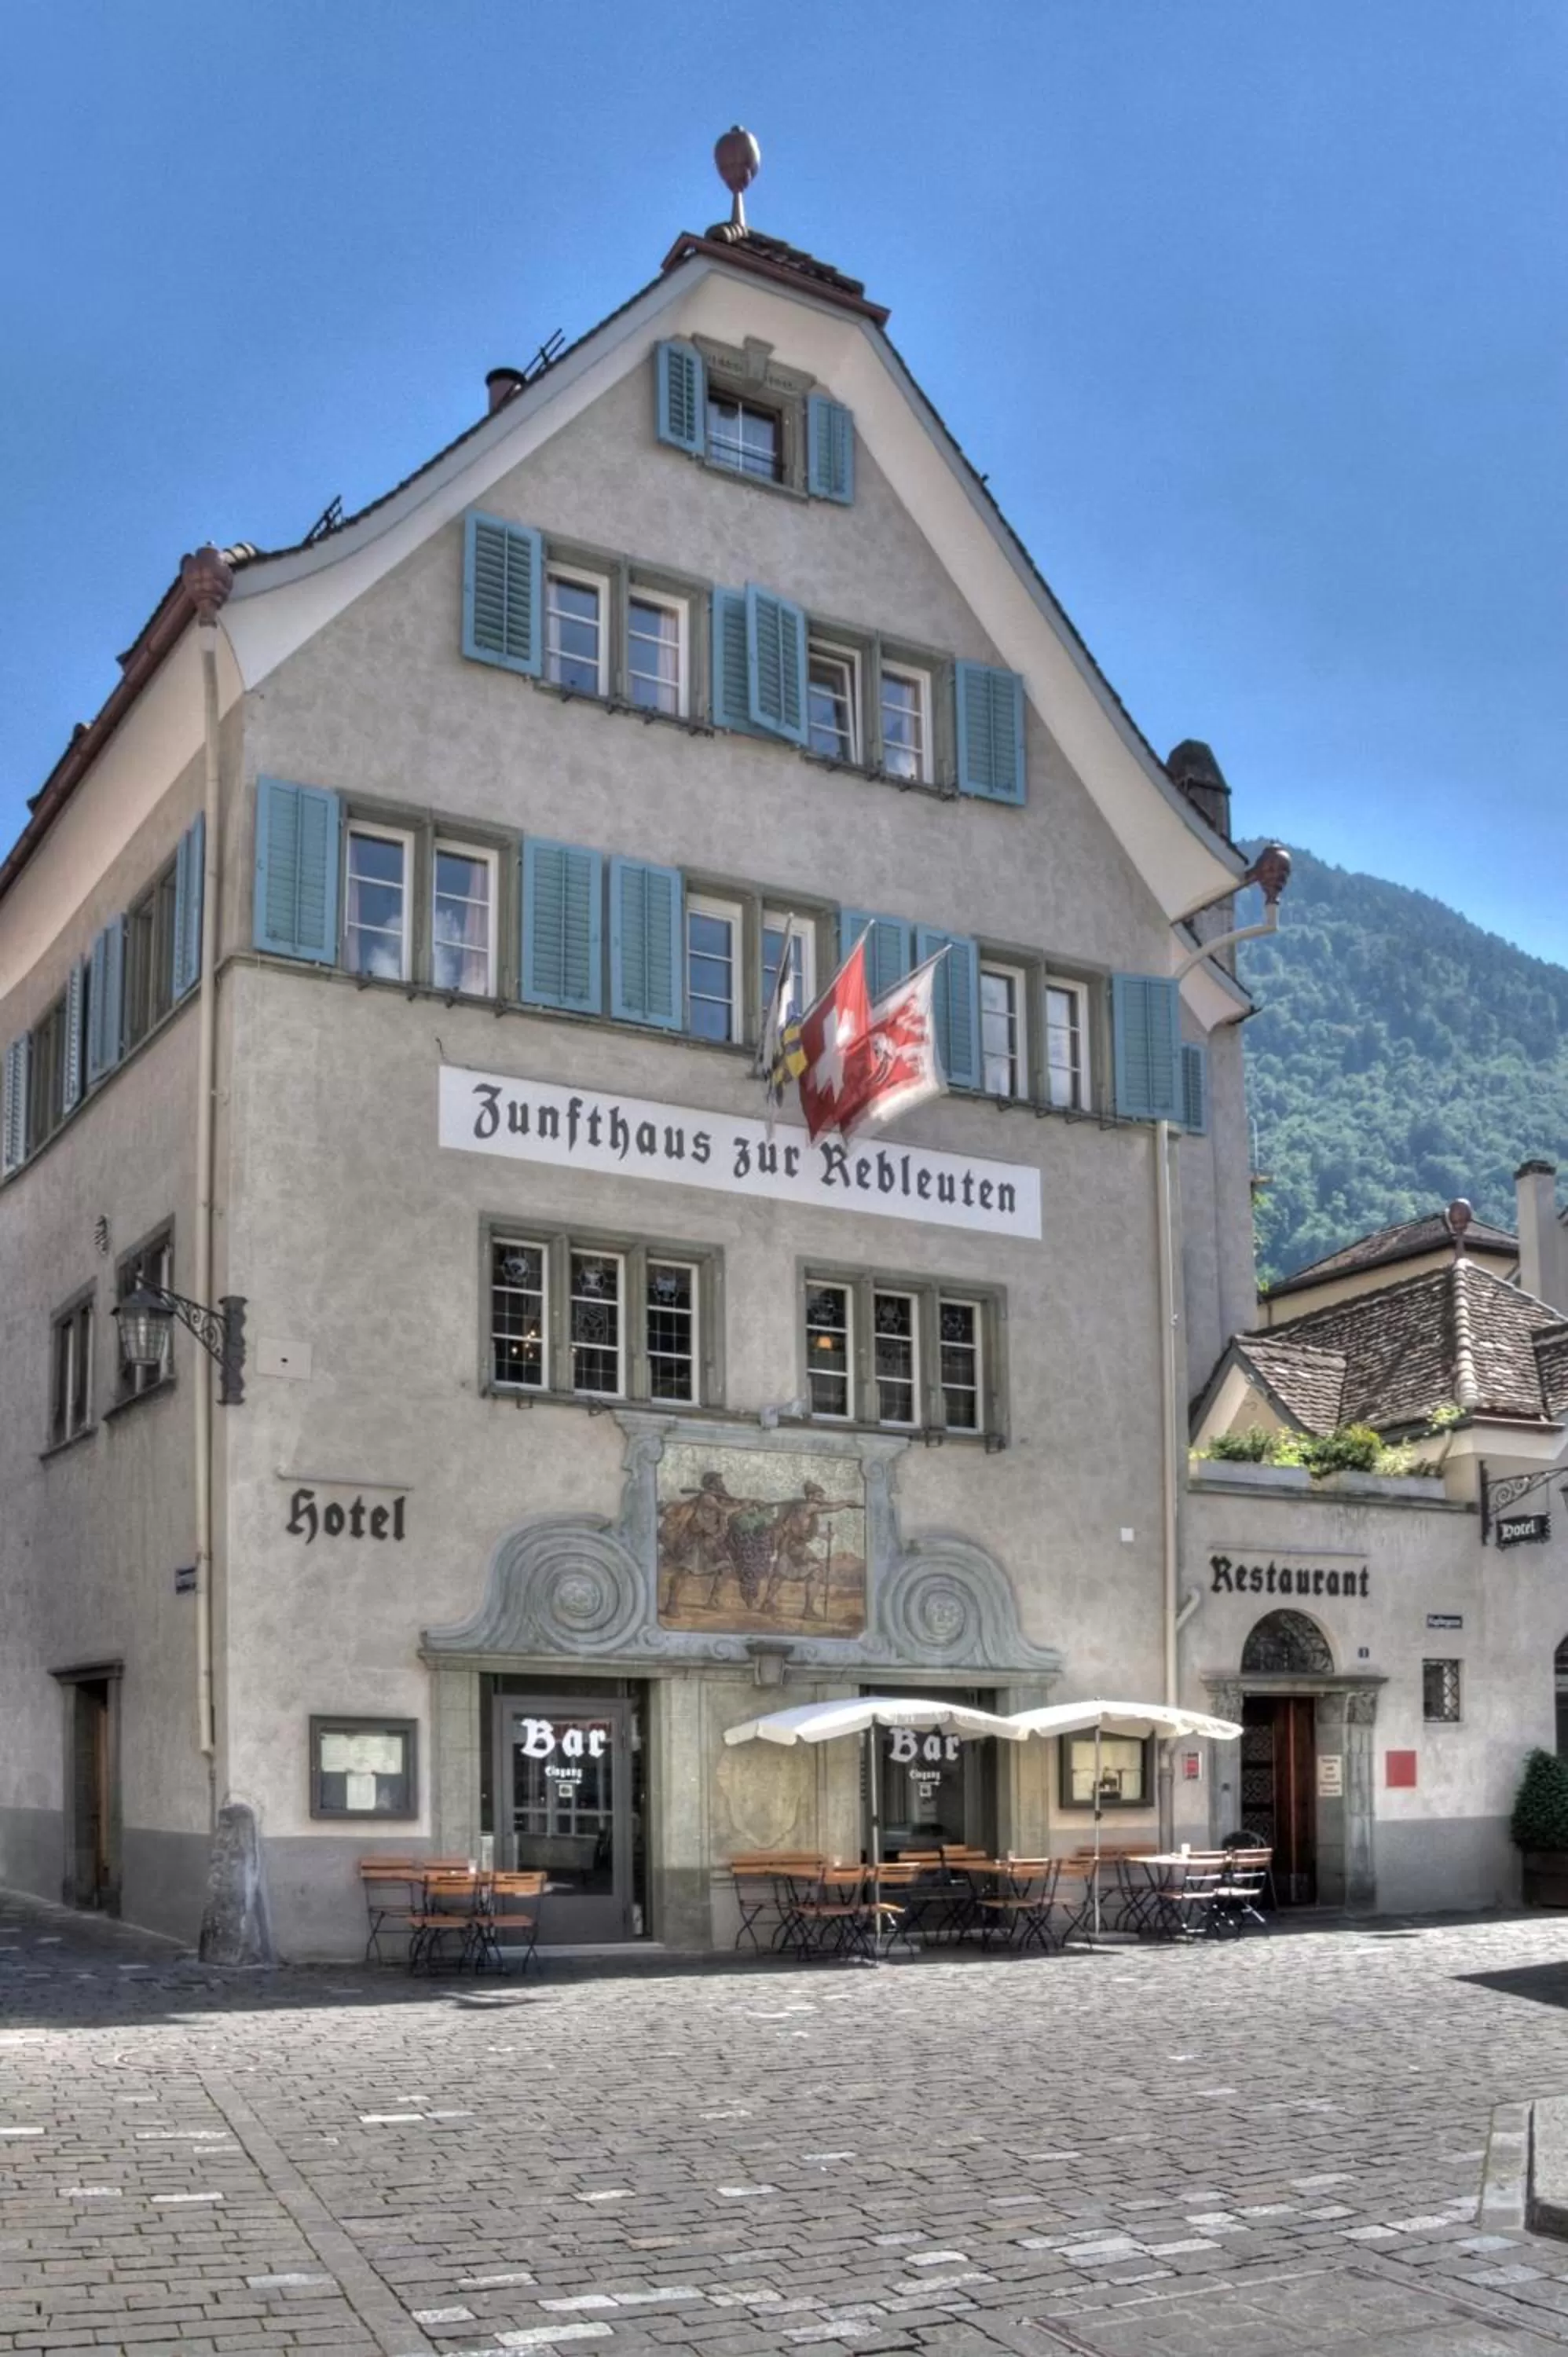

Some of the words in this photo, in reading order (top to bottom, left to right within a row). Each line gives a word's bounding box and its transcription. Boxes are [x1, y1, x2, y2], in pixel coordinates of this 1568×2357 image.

[472, 1083, 712, 1164] Zunfthaus
[821, 1141, 1016, 1214] Rebleuten
[285, 1488, 406, 1545] Hotel
[1209, 1555, 1369, 1598] Restaurant
[520, 1718, 606, 1758] Bar
[888, 1727, 960, 1762] Bar
